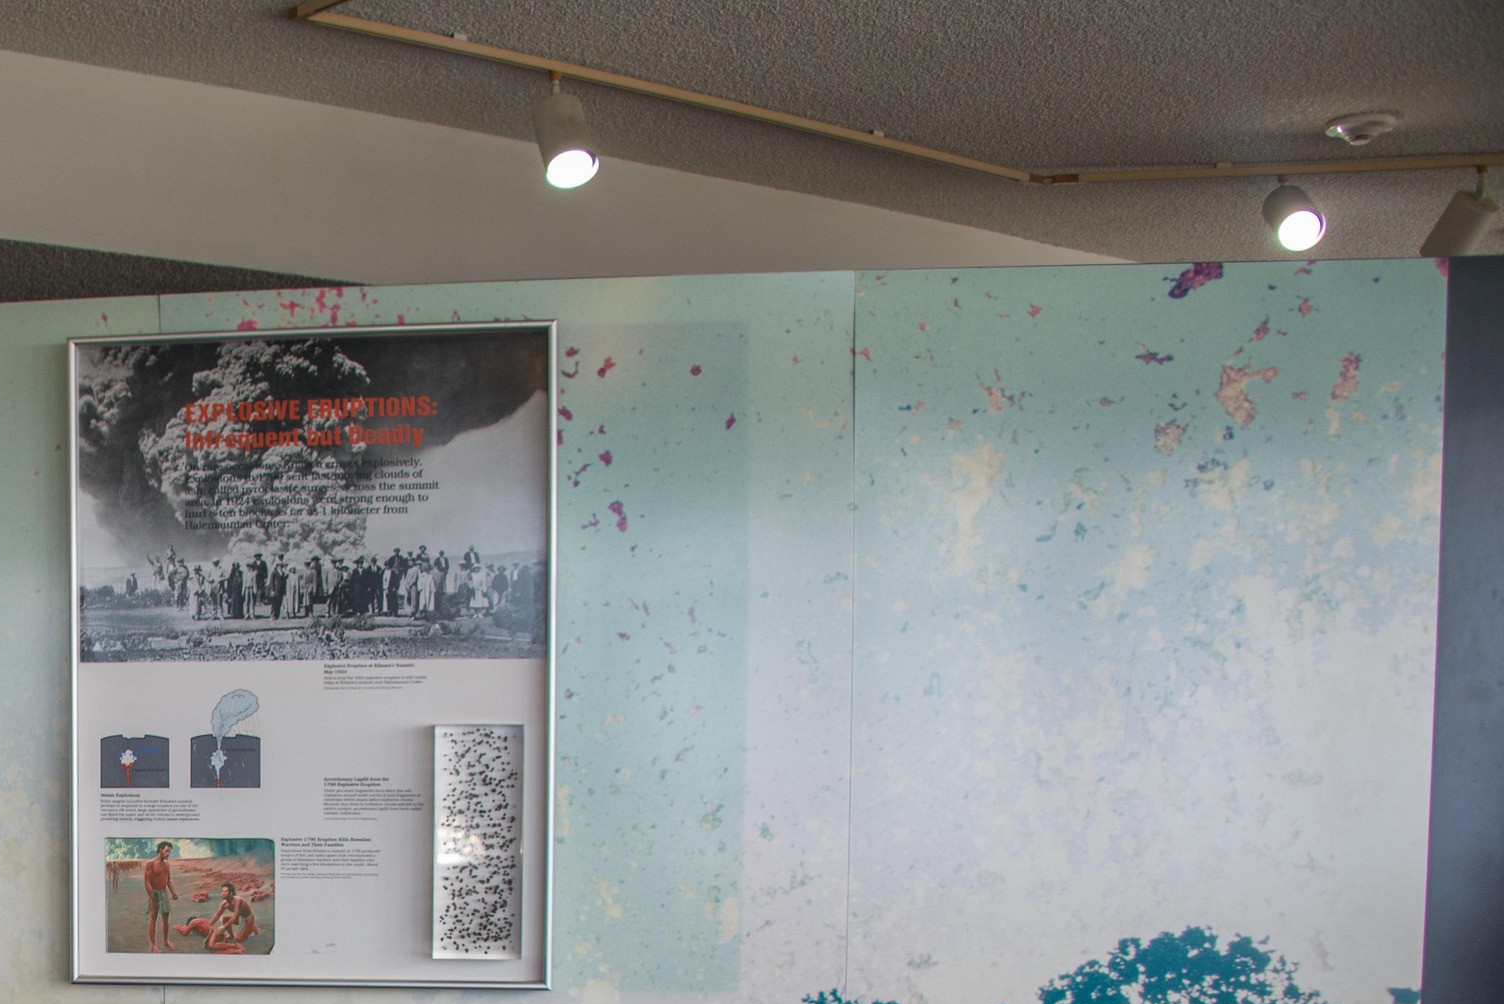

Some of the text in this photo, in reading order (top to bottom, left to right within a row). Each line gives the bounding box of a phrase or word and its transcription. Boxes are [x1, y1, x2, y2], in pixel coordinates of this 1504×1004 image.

[185, 395, 437, 422] EXPLOSIVE ERUPTIONS:
[185, 424, 423, 452] Infrequent but Deadly
[362, 458, 422, 467] explosively.
[374, 470, 409, 478] clouds
[411, 470, 422, 478] of
[379, 482, 396, 490] the
[399, 481, 439, 489] summit
[226, 497, 249, 505] 1924
[252, 496, 308, 505] explosions
[339, 495, 373, 504] strong
[375, 494, 415, 502] enough
[330, 506, 380, 514] kilometer
[383, 505, 408, 513] from
